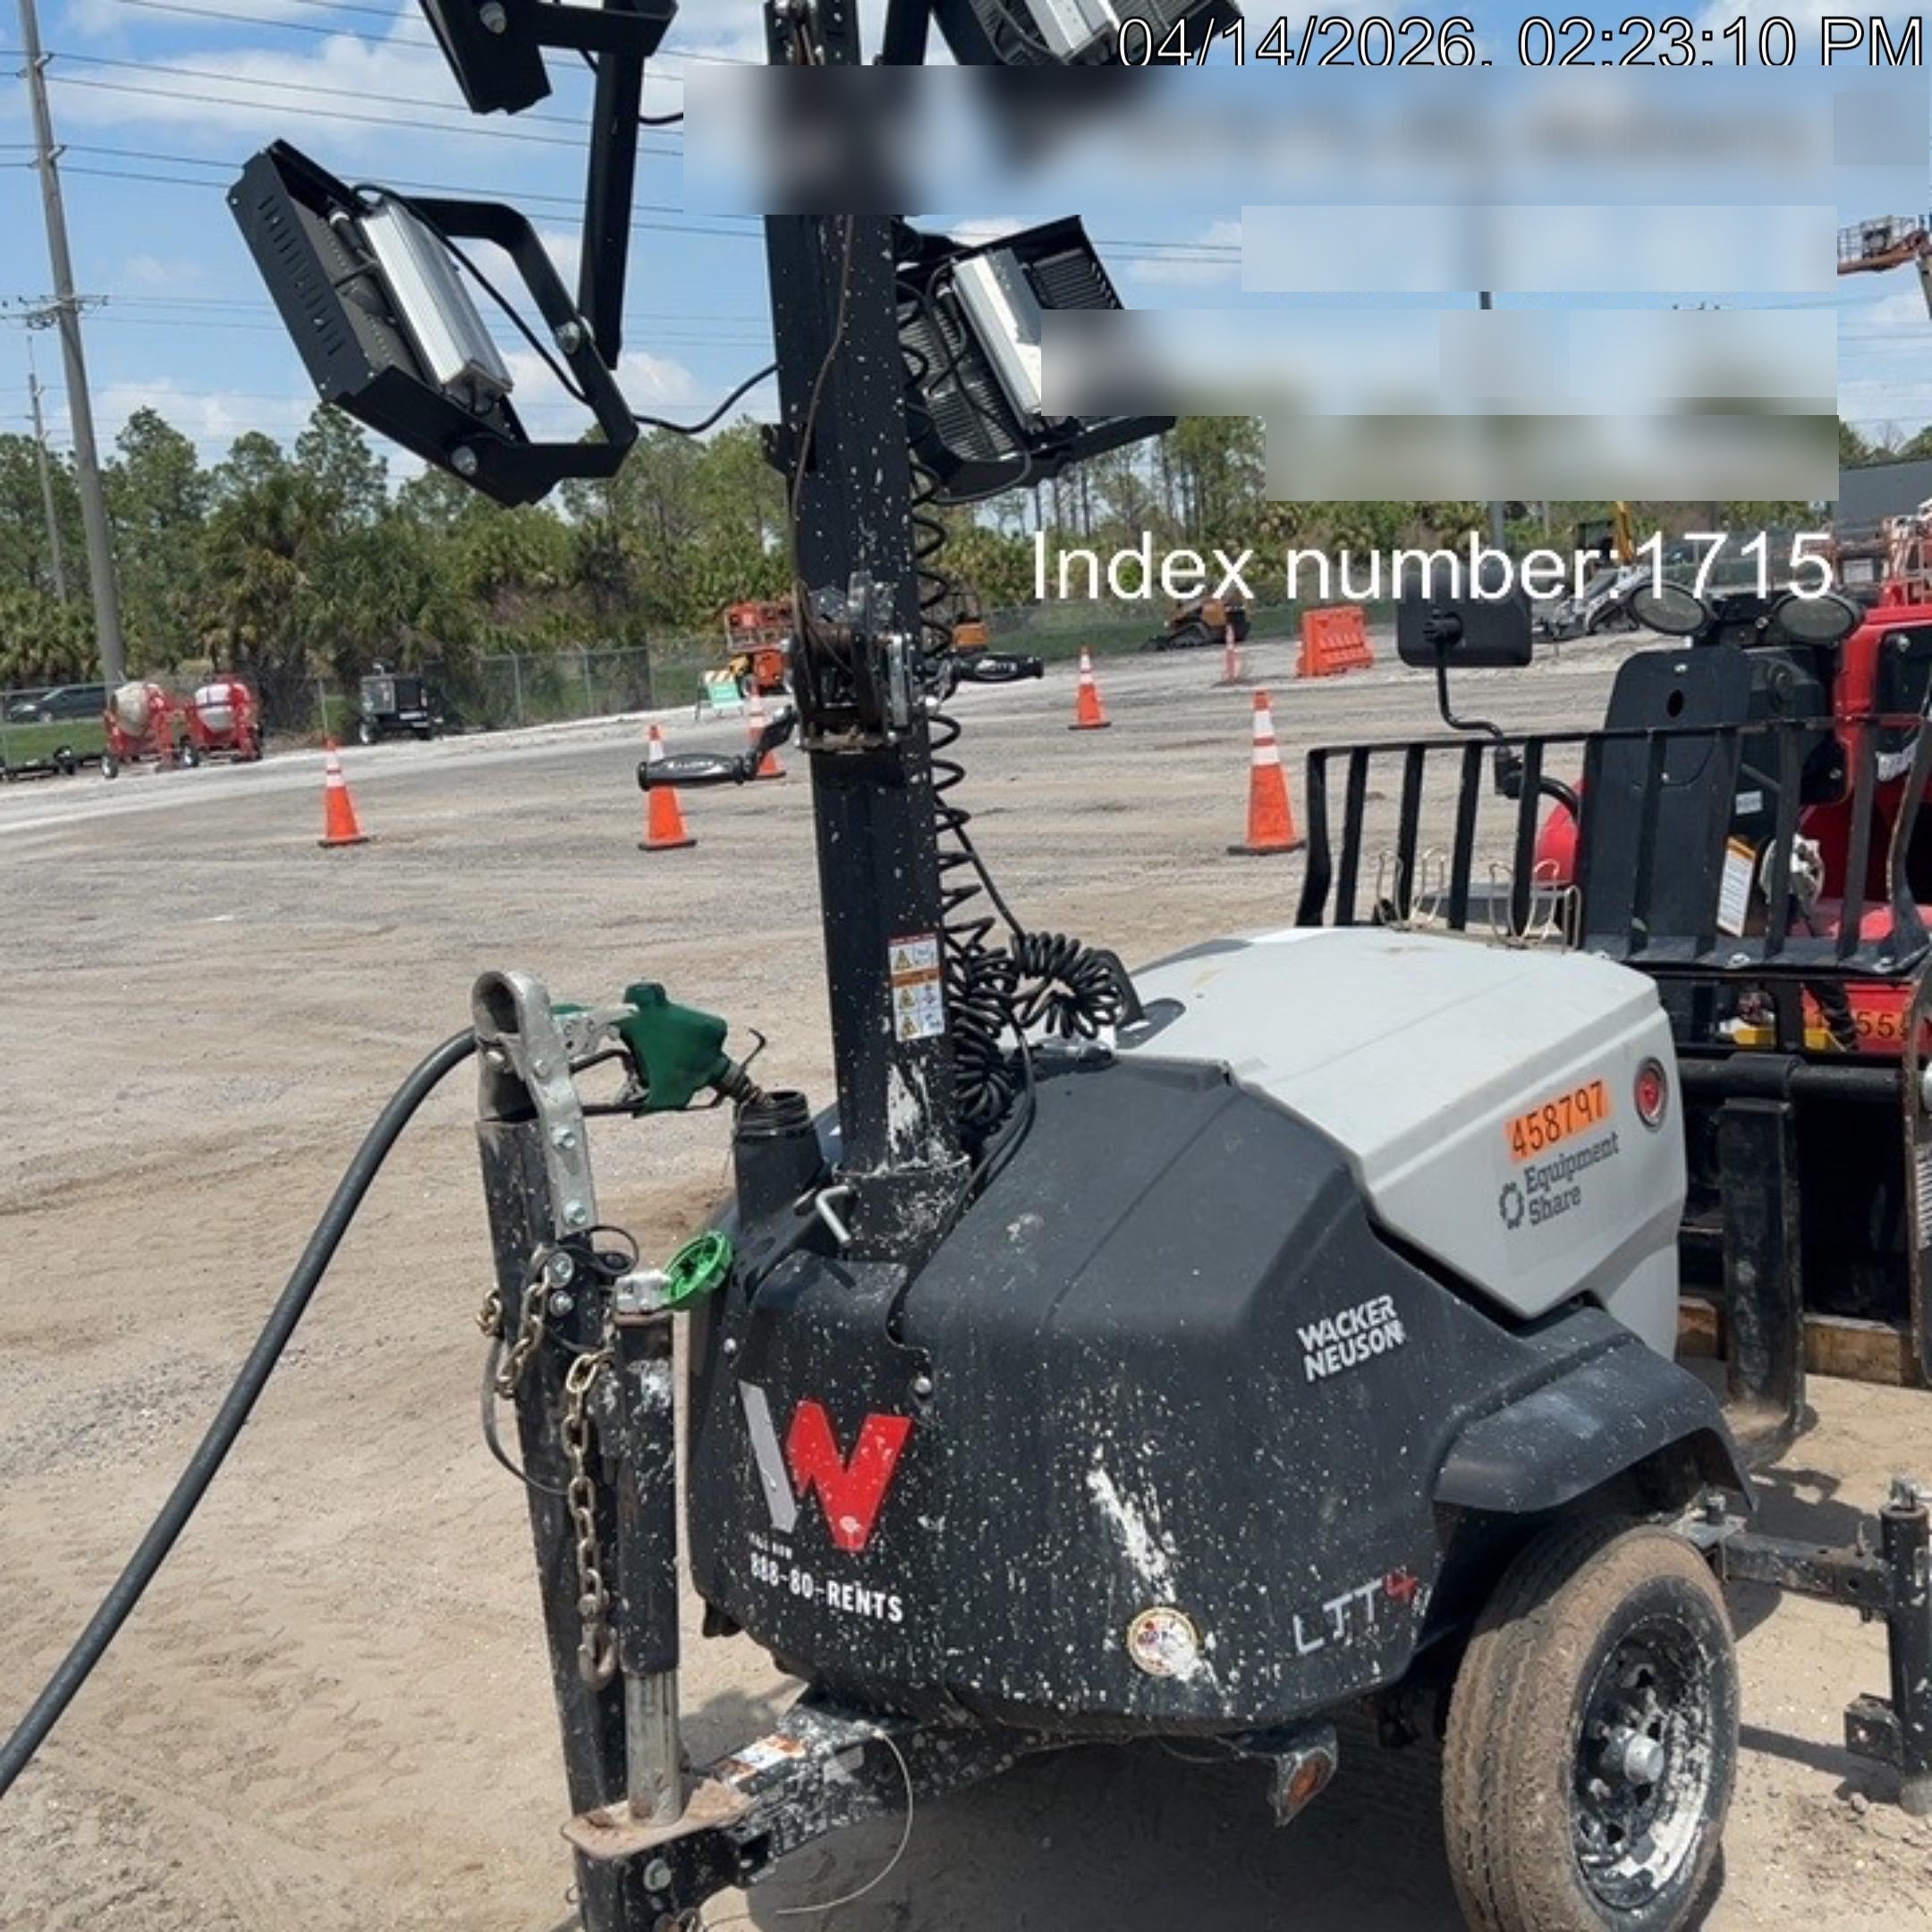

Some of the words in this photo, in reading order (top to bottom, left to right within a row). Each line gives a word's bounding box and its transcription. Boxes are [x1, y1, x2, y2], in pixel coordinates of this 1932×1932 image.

[1512, 1080, 1603, 1158] 458797
[1523, 1131, 1620, 1194] Equipment
[1528, 1185, 1582, 1226] Share
[1296, 1294, 1397, 1352] WACKER
[1303, 1318, 1406, 1383] NEUSON
